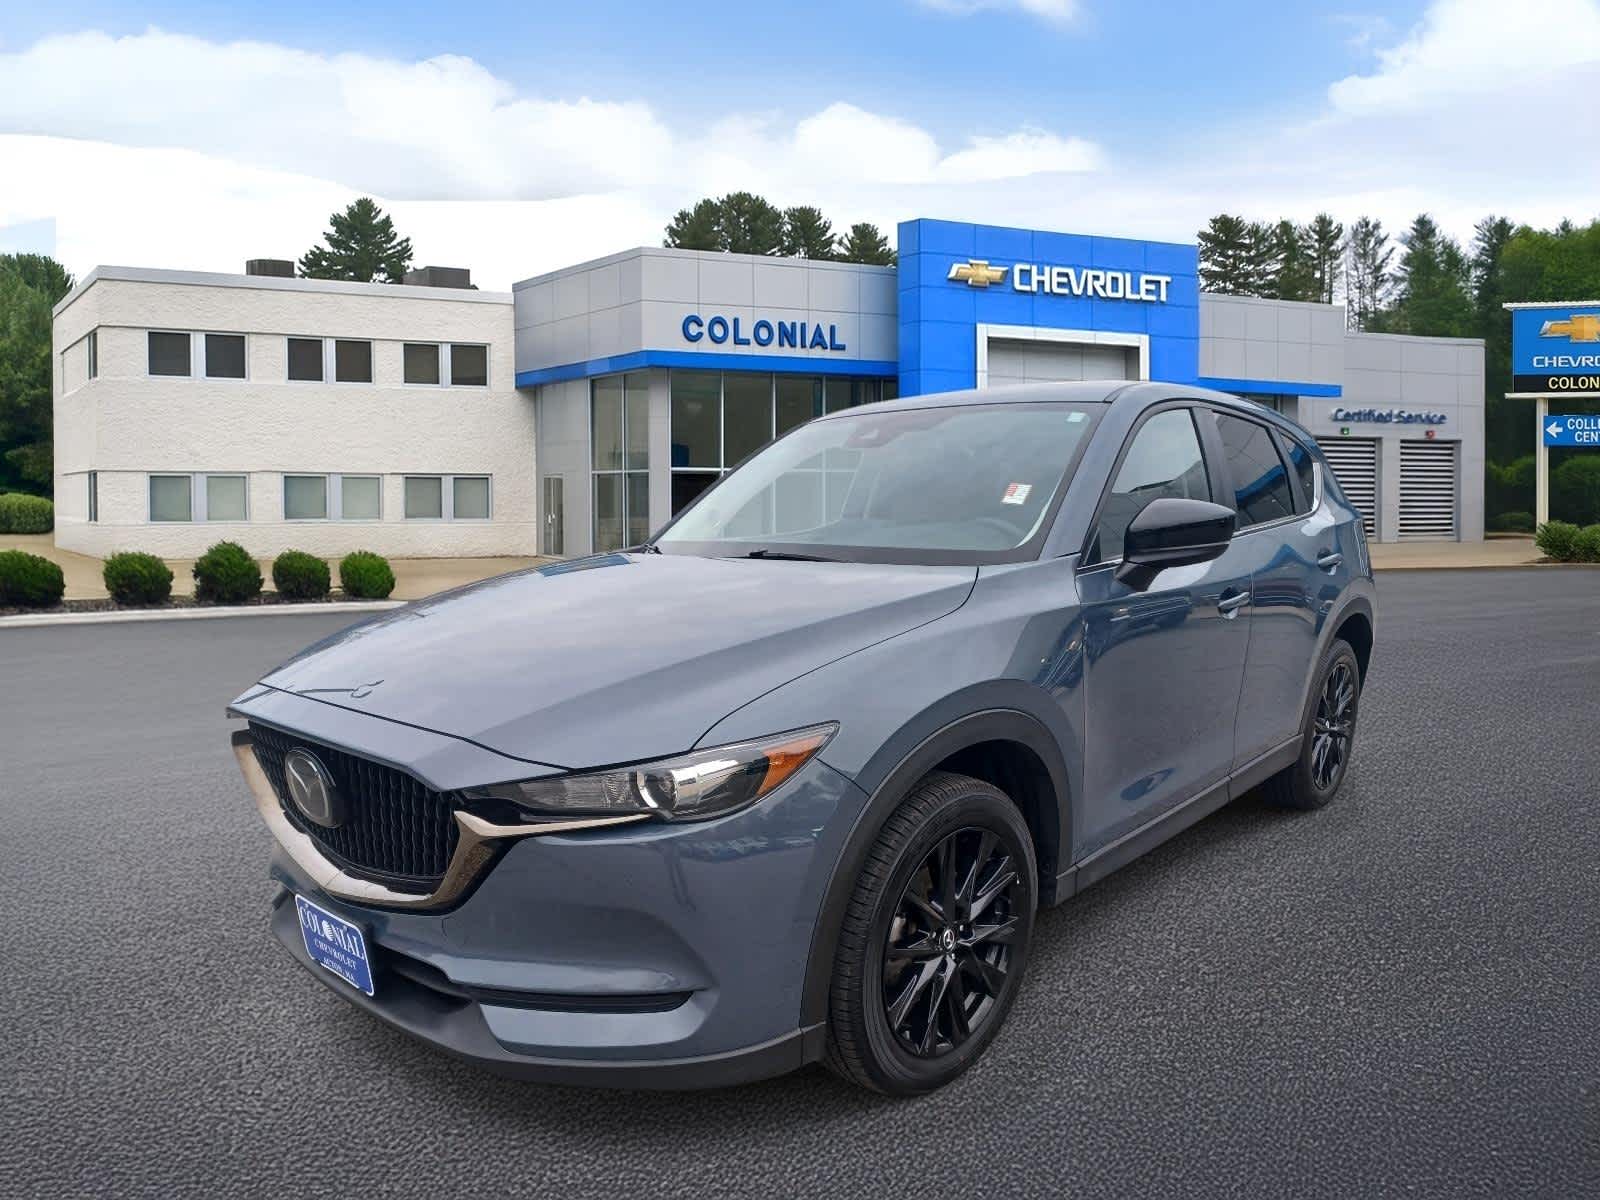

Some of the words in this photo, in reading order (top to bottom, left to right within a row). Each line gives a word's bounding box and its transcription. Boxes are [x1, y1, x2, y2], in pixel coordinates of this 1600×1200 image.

[1013, 263, 1172, 303] CHEVROLET
[682, 314, 846, 351] COLONIAL
[1332, 408, 1393, 423] Certified
[1394, 410, 1447, 424] Service
